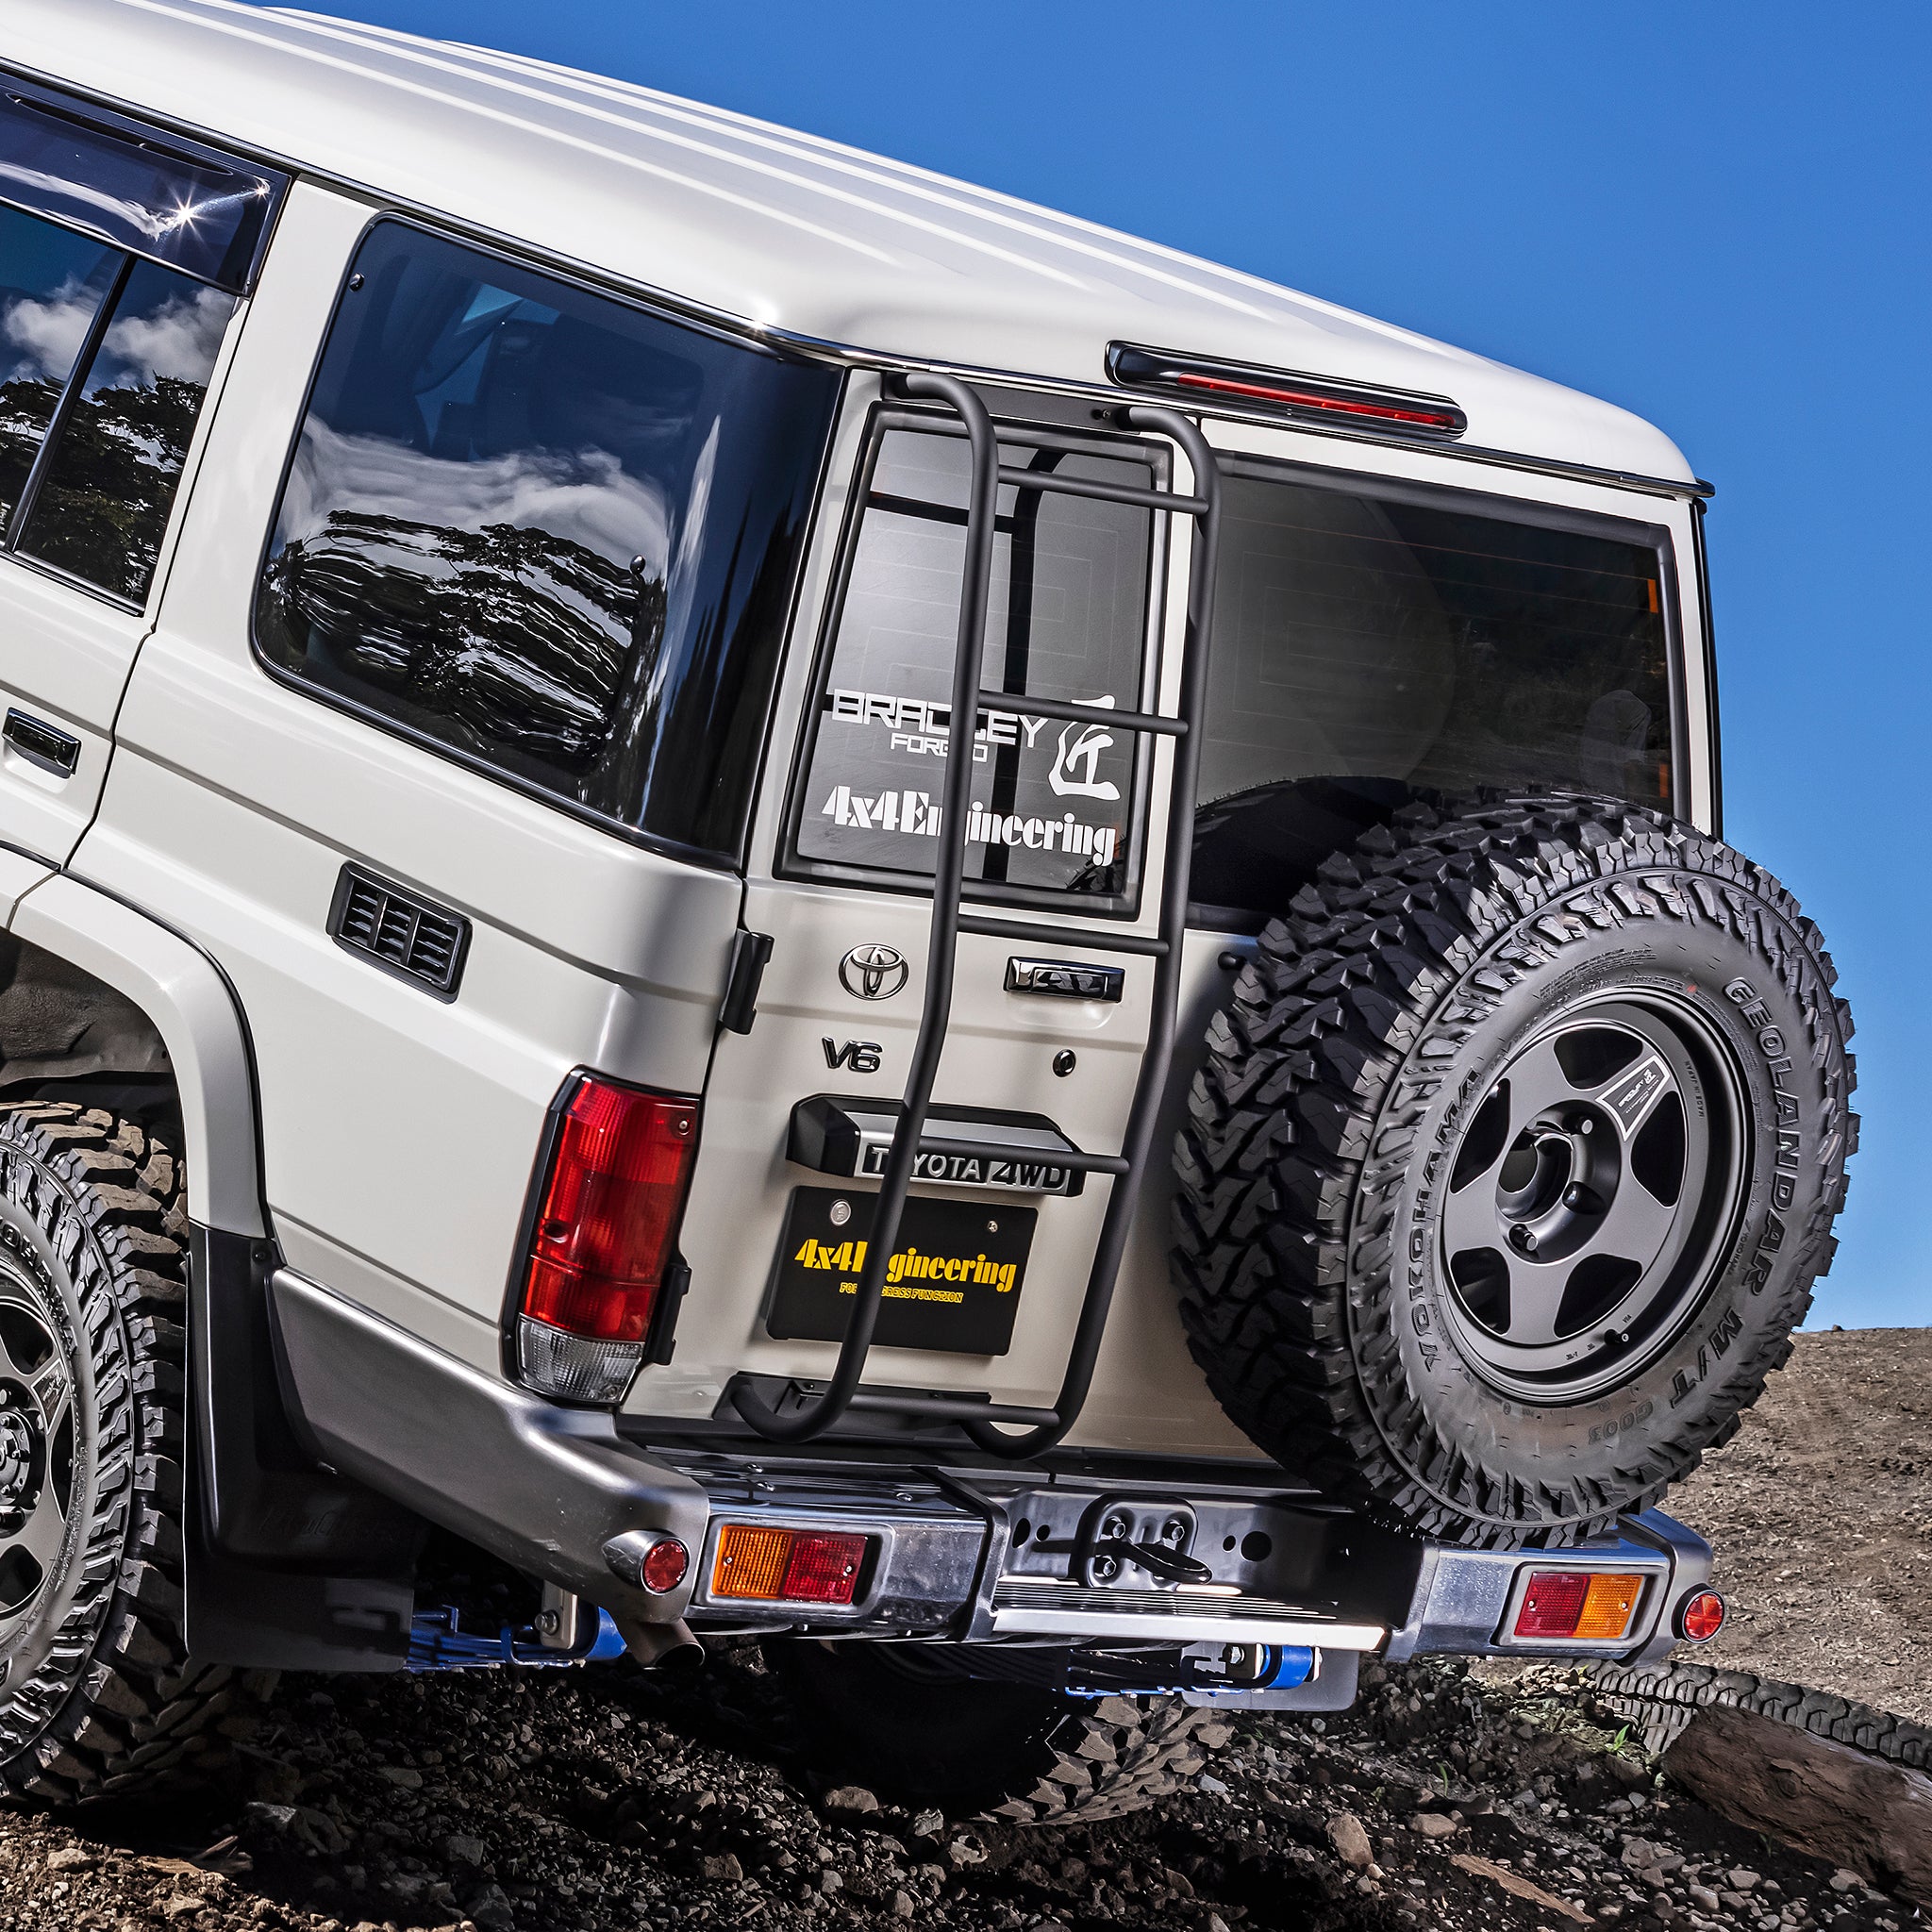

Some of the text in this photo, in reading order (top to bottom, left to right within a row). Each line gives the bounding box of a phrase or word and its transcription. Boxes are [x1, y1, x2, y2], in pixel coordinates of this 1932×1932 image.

[890, 732, 989, 763] FORGD
[1048, 694, 1121, 801] 匠
[821, 785, 1117, 867] 4x4Enineering
[822, 1037, 884, 1074] V6
[872, 1146, 1069, 1191] TYOTA 4WD
[1722, 976, 1800, 1297] GEOLANDAR
[1408, 1065, 1480, 1372] YOKOHAMA
[794, 1238, 1018, 1293] 4x4gineering
